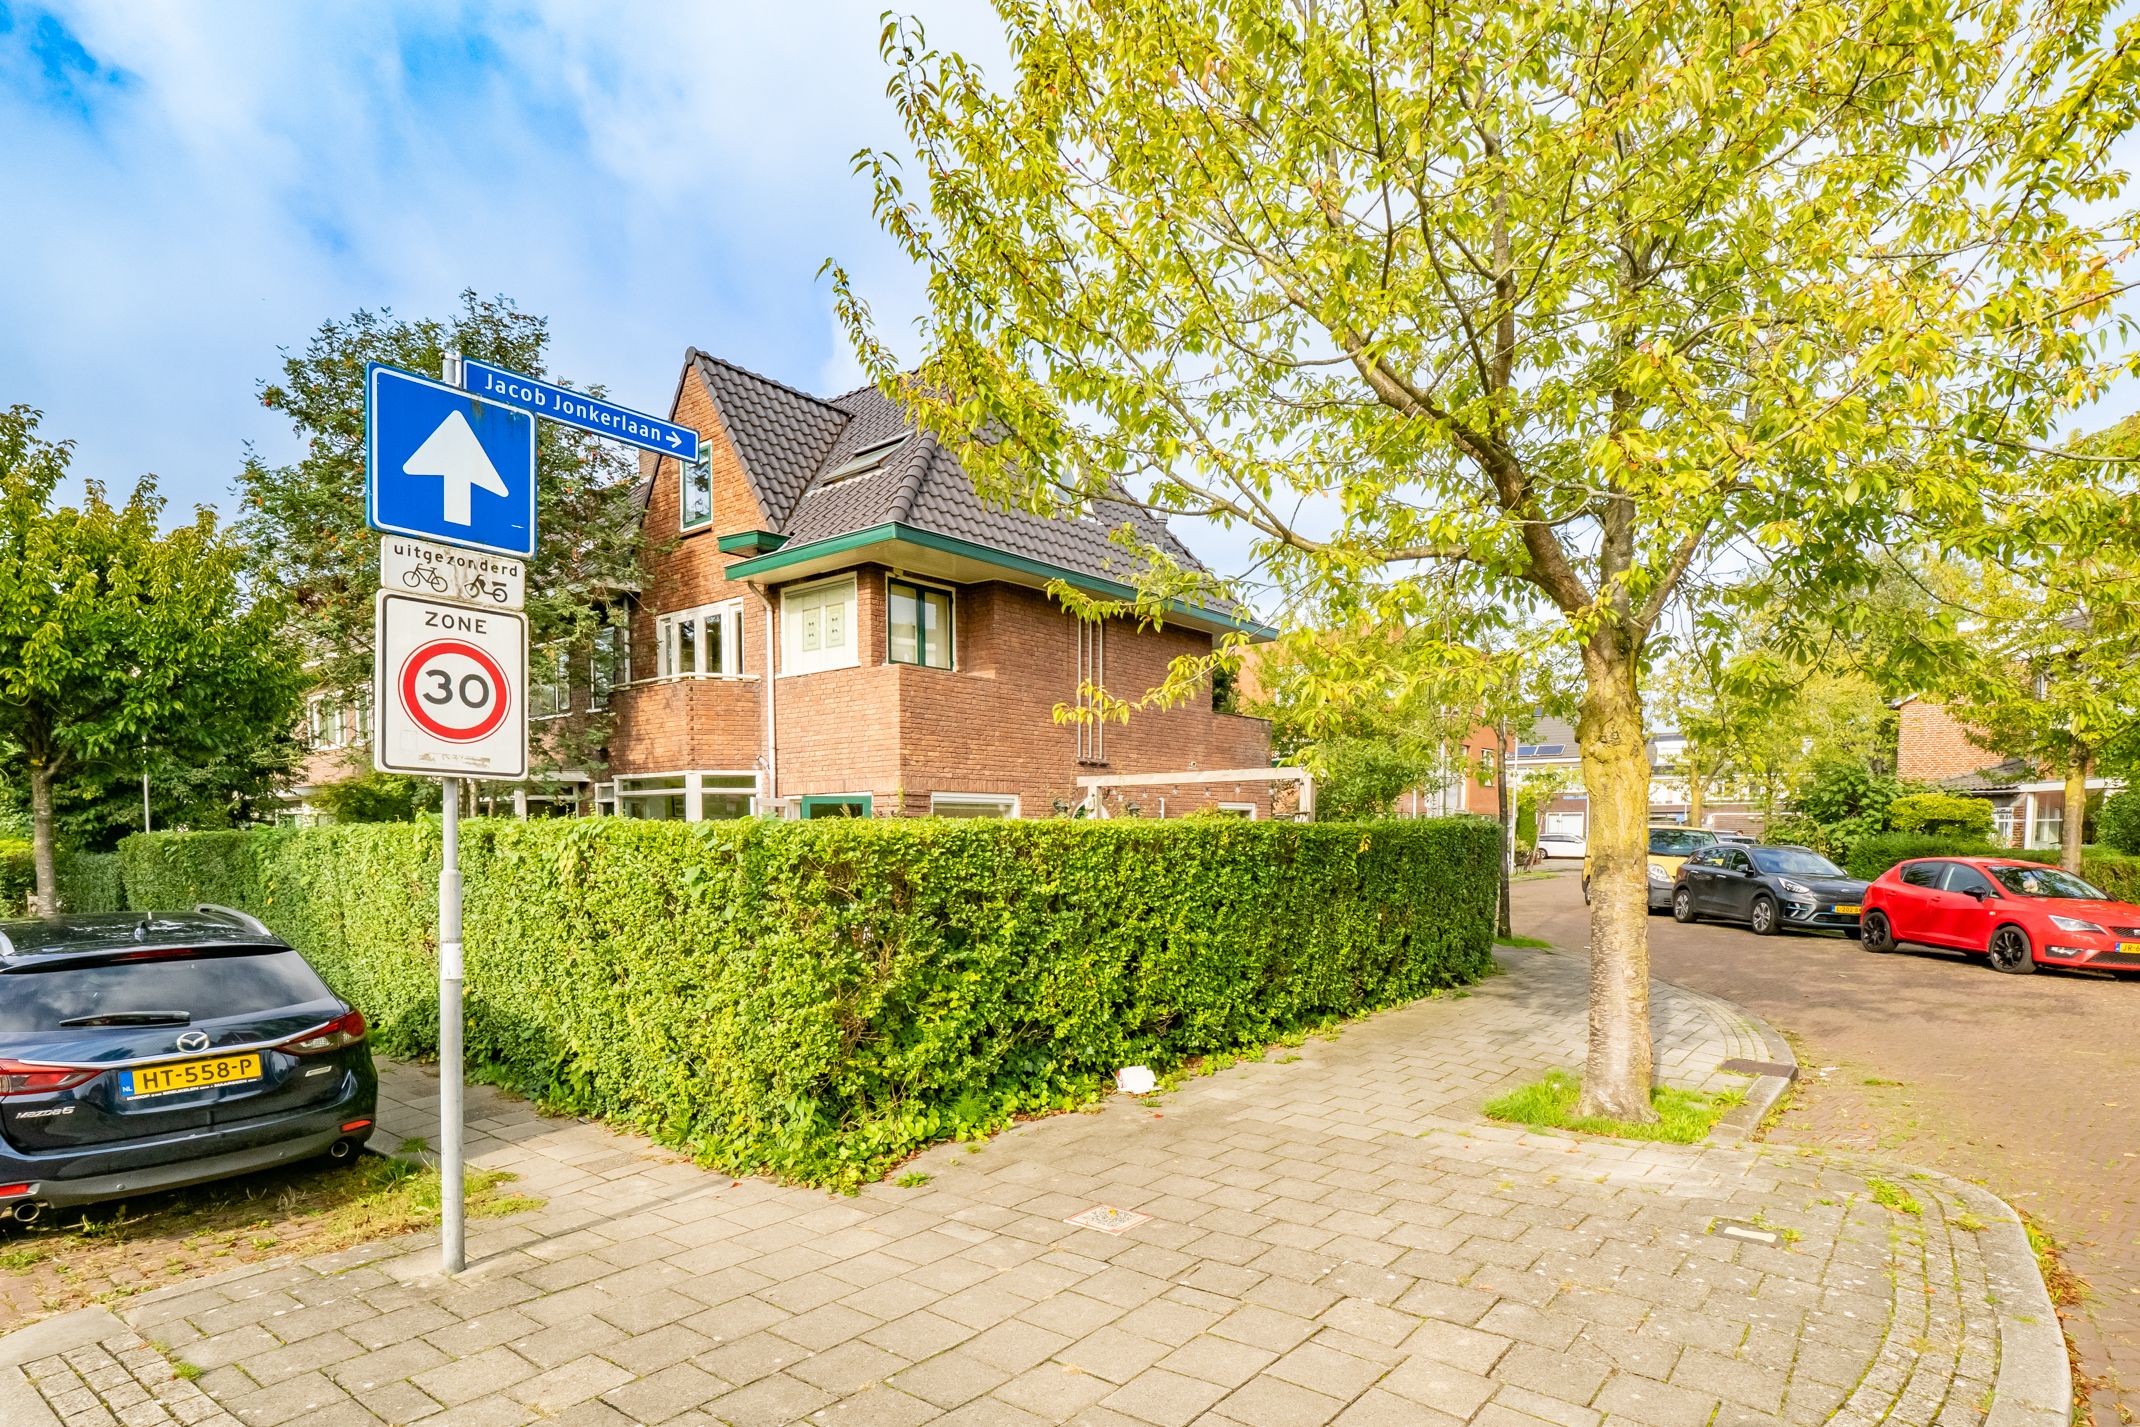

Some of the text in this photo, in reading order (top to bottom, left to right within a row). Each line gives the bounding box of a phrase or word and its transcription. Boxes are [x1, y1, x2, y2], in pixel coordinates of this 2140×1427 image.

[485, 373, 661, 442] Jacob Jonkerlaan
[394, 544, 518, 577] uitgezonderd
[425, 611, 487, 634] ZONE
[422, 669, 490, 709] 30
[142, 1058, 252, 1090] HT-558-P
